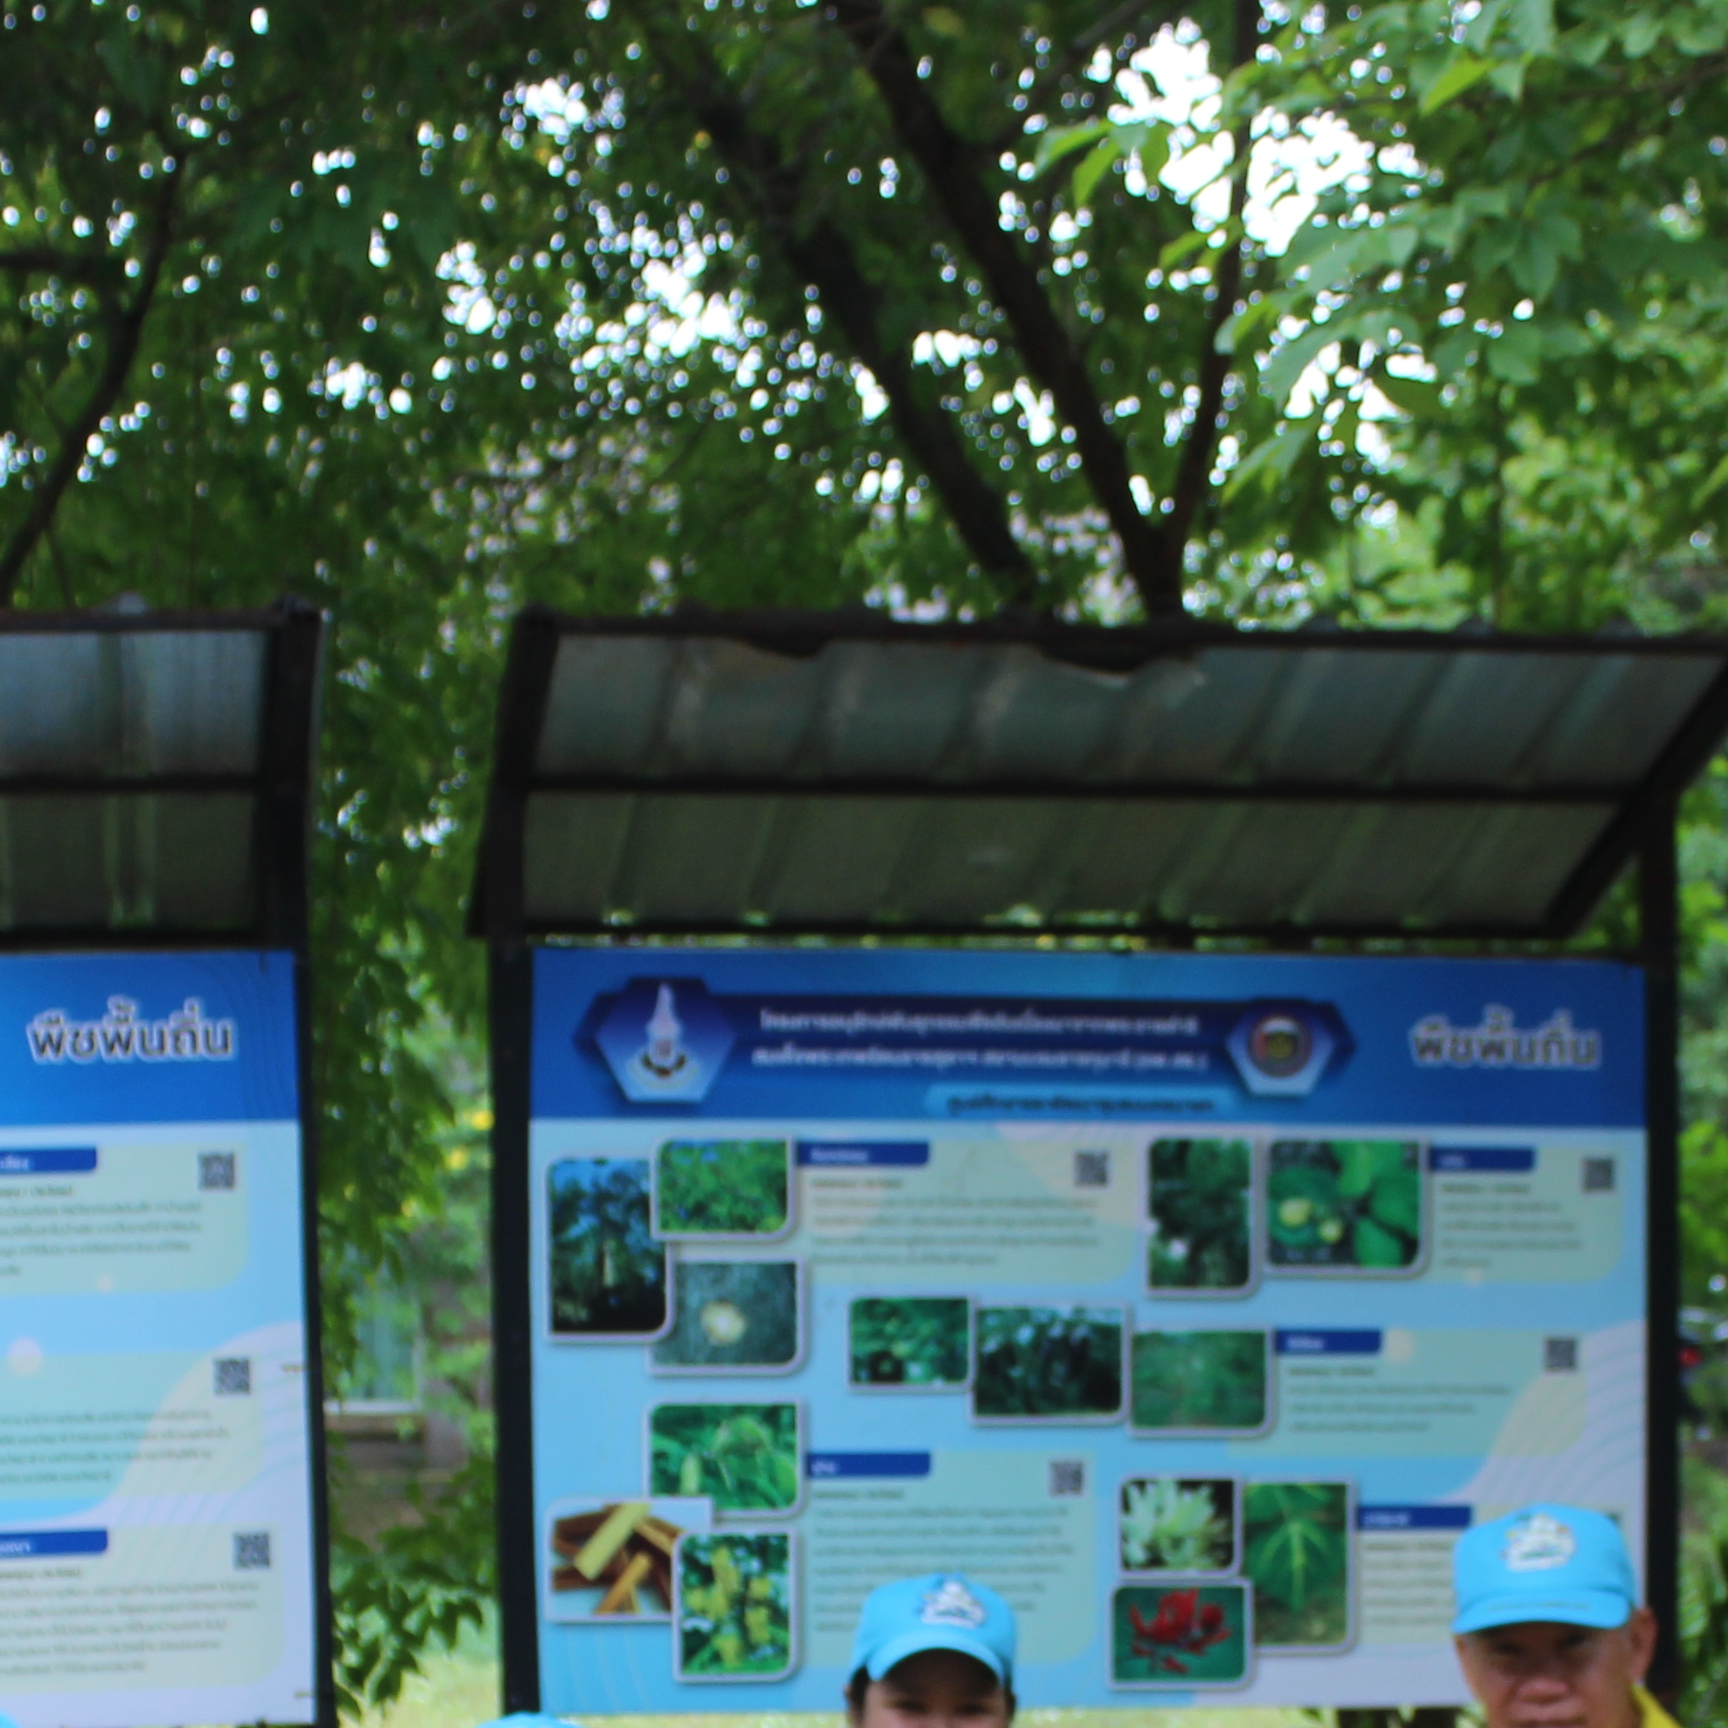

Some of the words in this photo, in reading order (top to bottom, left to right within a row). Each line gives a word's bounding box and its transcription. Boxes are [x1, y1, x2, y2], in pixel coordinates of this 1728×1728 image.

[26, 993, 239, 1065] พืชพื้นถิ่น
